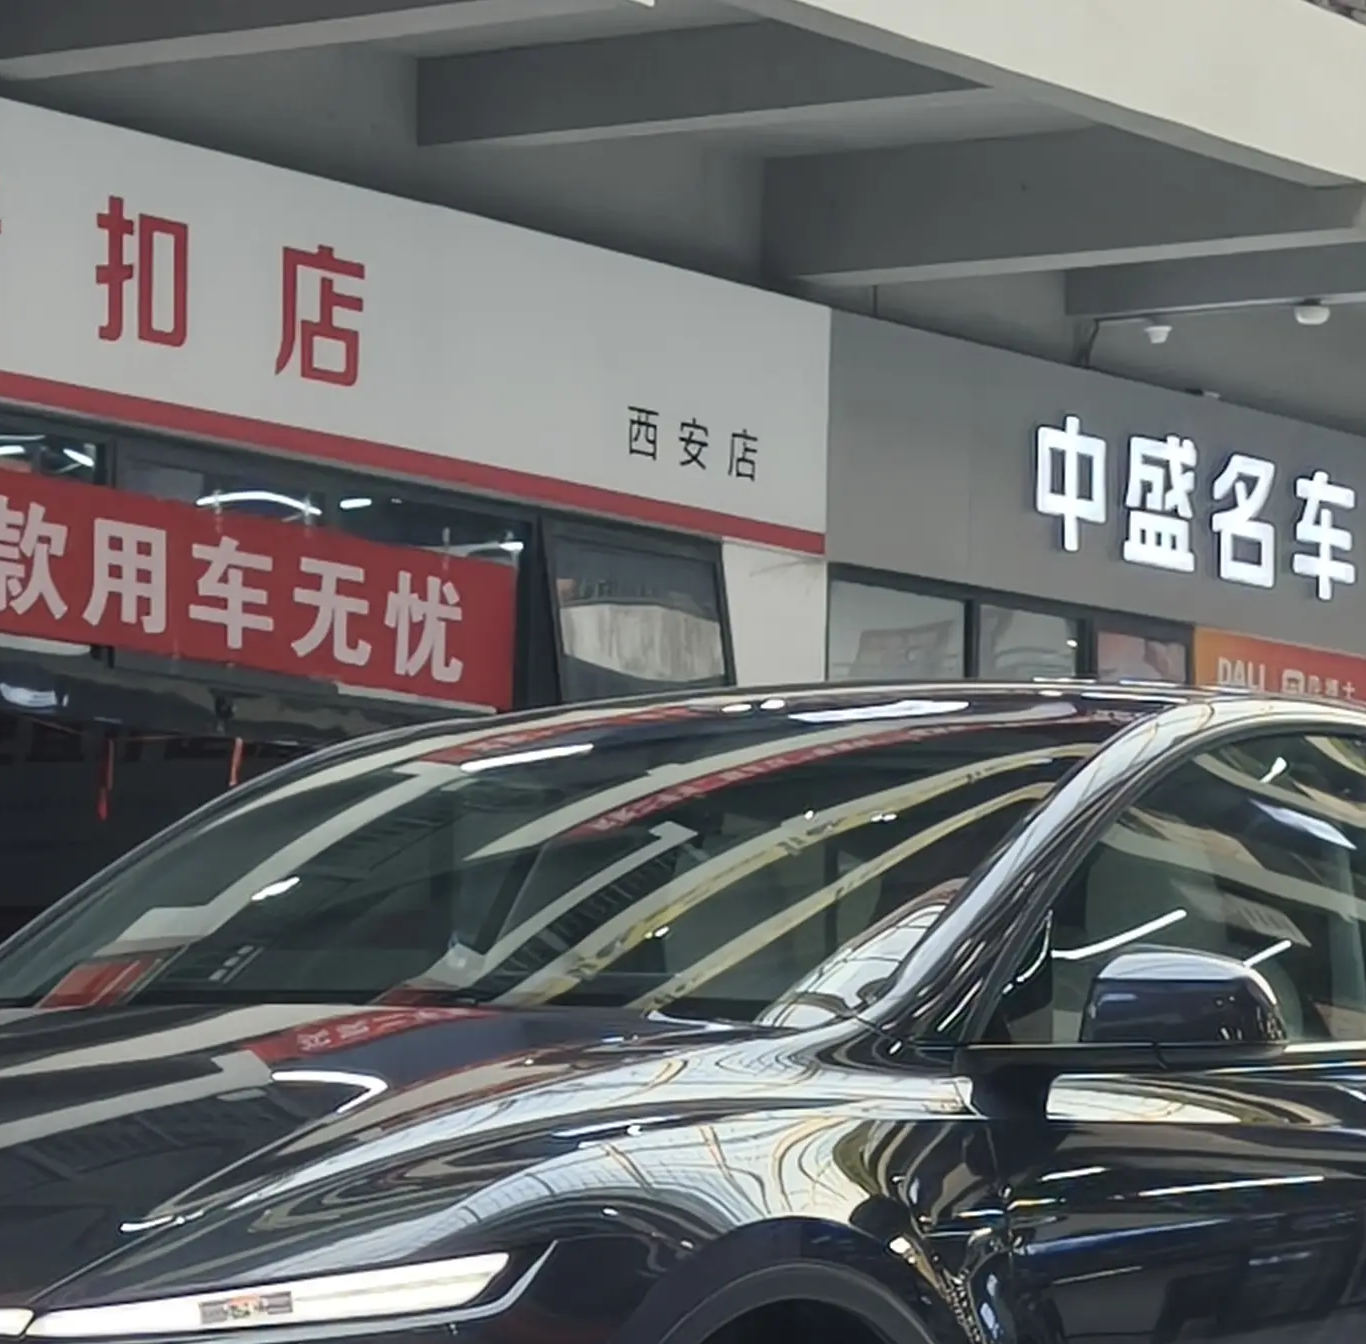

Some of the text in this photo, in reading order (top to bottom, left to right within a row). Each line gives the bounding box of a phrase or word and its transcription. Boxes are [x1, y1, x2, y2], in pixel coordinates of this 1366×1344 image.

[627, 405, 759, 482] 西安店
[1035, 416, 1357, 601] 中盛名车
